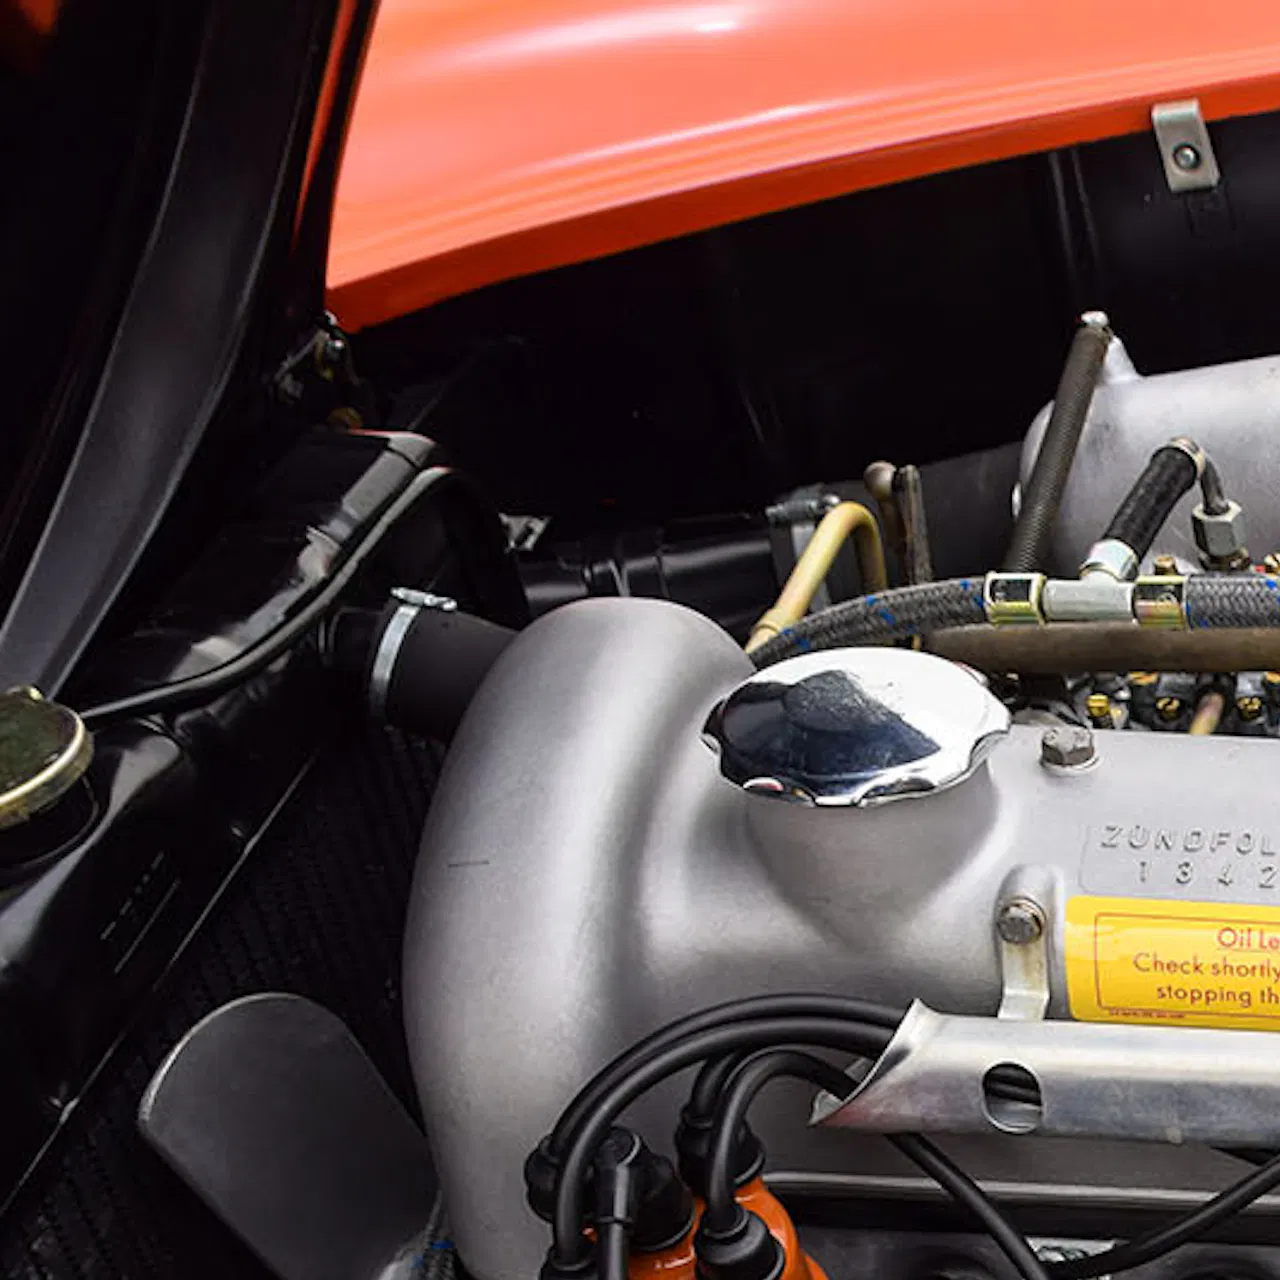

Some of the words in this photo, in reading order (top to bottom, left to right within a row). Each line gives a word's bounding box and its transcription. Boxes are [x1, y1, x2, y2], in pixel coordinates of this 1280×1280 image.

[1138, 860, 1148, 883] 1
[1257, 864, 1279, 890] 2
[1216, 926, 1252, 949] Oil
[1132, 952, 1204, 975] Check
[1156, 984, 1252, 1008] stopping
